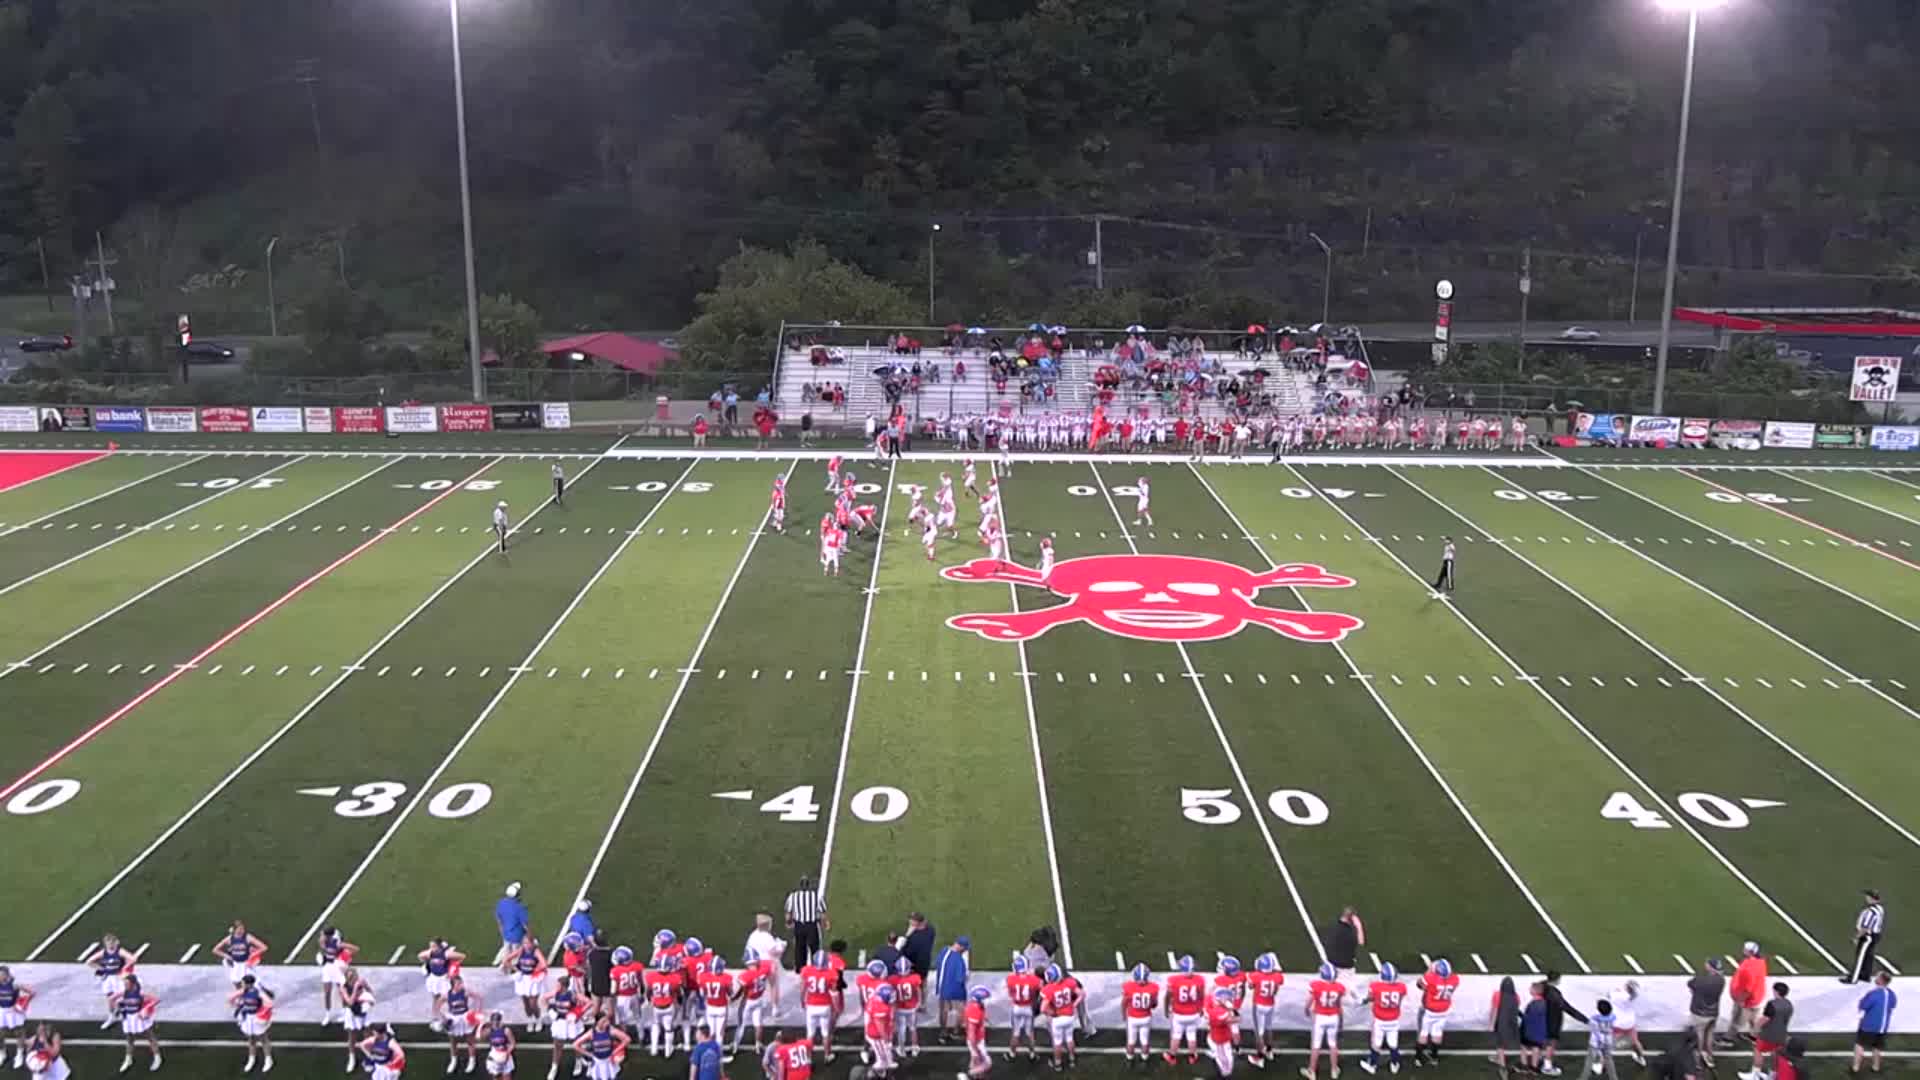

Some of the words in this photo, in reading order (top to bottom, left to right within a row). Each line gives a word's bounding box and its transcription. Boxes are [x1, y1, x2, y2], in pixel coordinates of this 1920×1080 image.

[1853, 384, 1895, 400] VALLEY
[111, 410, 142, 421] bank
[334, 781, 492, 818] 30
[760, 785, 909, 822] 40
[1181, 788, 1329, 825] 50
[1600, 792, 1749, 828] 40
[619, 972, 637, 990] 20
[652, 982, 670, 997] 24
[808, 976, 826, 993] 34
[1260, 980, 1275, 997] 51
[705, 982, 721, 998] 17
[897, 983, 913, 1000] 13
[1015, 984, 1030, 1000] 14
[1179, 985, 1197, 1002] 64
[1132, 992, 1151, 1008] 60
[1319, 991, 1338, 1007] 42
[1381, 991, 1400, 1008] 59
[788, 1045, 808, 1068] 50
